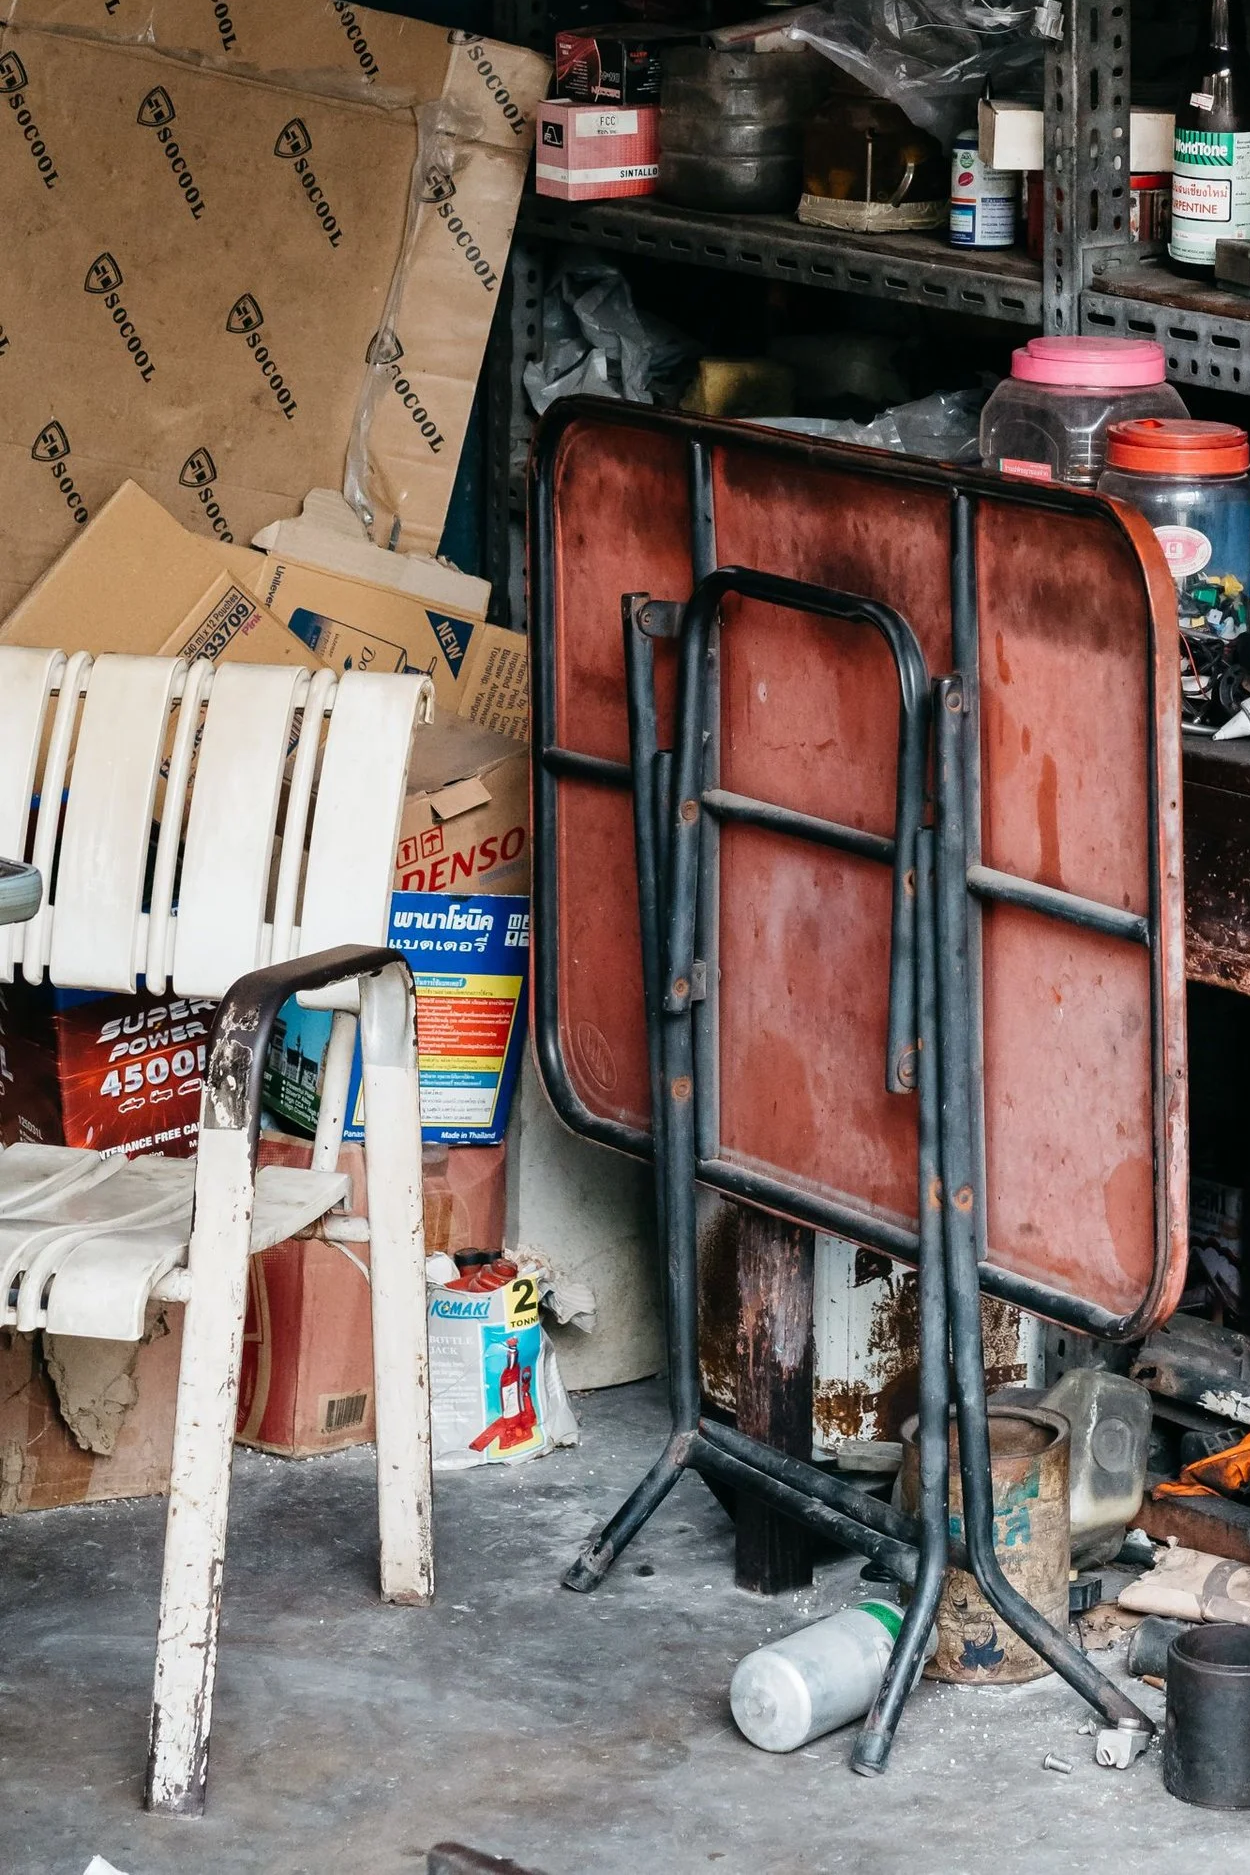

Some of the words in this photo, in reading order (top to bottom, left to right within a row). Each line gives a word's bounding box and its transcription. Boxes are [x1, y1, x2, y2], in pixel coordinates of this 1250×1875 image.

[468, 45, 529, 136] SOCOOL
[8, 93, 59, 190] SOCOOL
[600, 116, 616, 126] FCC
[1174, 139, 1228, 157] WorldTone
[156, 126, 206, 220] SOCOOL
[294, 157, 343, 248] SOCOOL
[437, 202, 498, 292] SOCOOL
[103, 292, 156, 384] SOCOOL
[246, 332, 298, 421] SOCOOL
[265, 565, 286, 609] Unilever
[184, 642, 196, 658] 540
[206, 619, 215, 630] 12
[214, 593, 239, 622] Pouches
[241, 614, 263, 636] Pink
[436, 621, 463, 661] NEW
[402, 826, 525, 892] DENSO
[393, 904, 494, 931] พานาโซนิค
[388, 933, 490, 953] แบตเตอรี่
[96, 998, 217, 1045] SUPER
[108, 1021, 208, 1063] POWER
[155, 1128, 181, 1144] FREE
[469, 1132, 496, 1140] Thailand
[512, 1279, 537, 1314] 2
